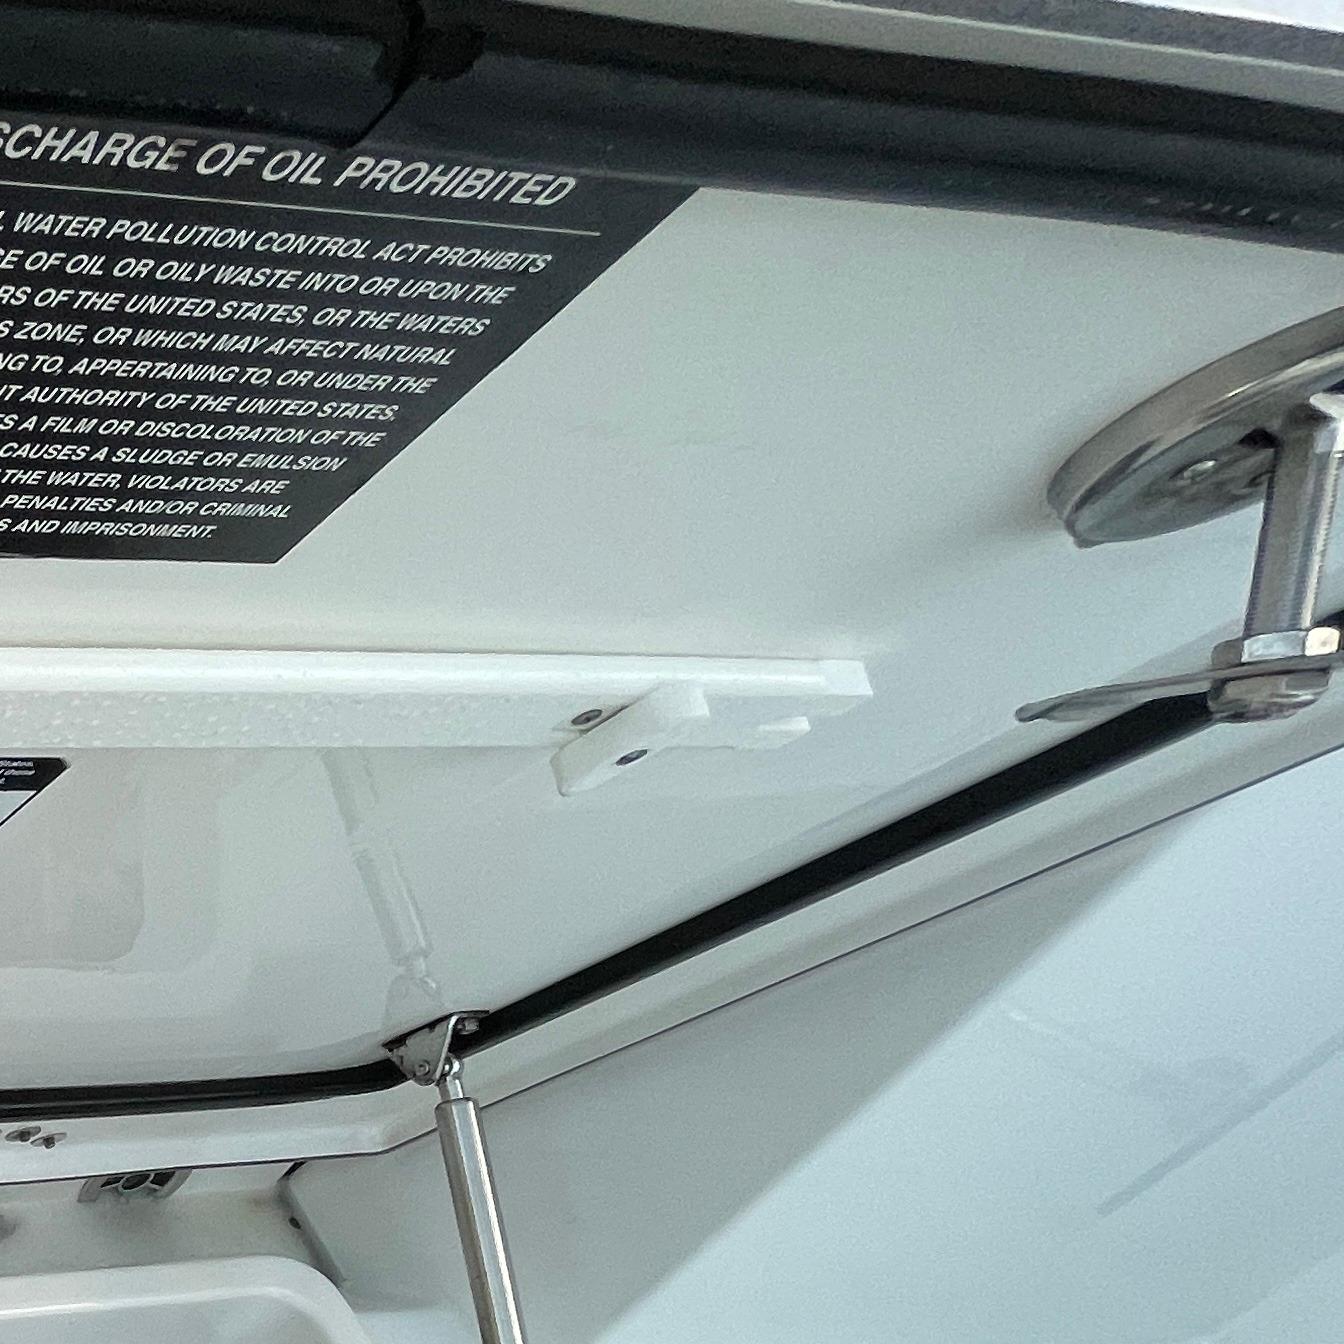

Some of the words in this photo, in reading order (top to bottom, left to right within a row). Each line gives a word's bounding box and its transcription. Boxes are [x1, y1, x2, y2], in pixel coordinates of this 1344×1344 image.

[196, 141, 260, 178] OF
[261, 146, 328, 186] OIL
[331, 156, 578, 206] PROHIBITED
[12, 210, 108, 239] WATER
[105, 218, 257, 250] POLLUTION
[254, 231, 372, 259] CONTROL
[371, 241, 432, 263] ACT
[423, 245, 553, 273] PROHIBITS
[24, 250, 68, 272] OF
[64, 254, 106, 276] OIL
[112, 257, 156, 279] OR
[154, 260, 217, 283] OILY
[212, 264, 303, 290] WASTE
[297, 271, 360, 294] INTO
[358, 276, 402, 297] OR
[397, 278, 470, 301] UPON
[464, 283, 516, 305] THE
[33, 287, 76, 308] OF
[72, 289, 126, 312] THE
[124, 293, 217, 318] UNITED
[215, 300, 309, 327] STATES,
[312, 307, 353, 327] OR
[349, 310, 402, 330] THE
[395, 312, 491, 336] WATERS
[12, 321, 88, 346] ZONE,
[92, 326, 133, 346] OR
[131, 328, 216, 351] WHICH
[210, 333, 269, 354] MAY
[263, 337, 361, 359] AFFECT
[353, 343, 457, 366] NATURAL
[30, 353, 65, 376] TO,
[67, 357, 241, 383] APPERTAINING
[238, 367, 273, 388] TO,
[276, 369, 316, 387] OR
[313, 371, 394, 392] UNDER
[390, 376, 439, 394] THE
[18, 385, 157, 409] AUTHORITY
[154, 392, 193, 410] OF
[189, 394, 238, 413] THE
[235, 396, 319, 417] UNITED
[17, 415, 39, 432] A
[39, 415, 99, 434] FILM
[97, 418, 136, 436] OR
[133, 420, 313, 444] DISCOLORATION
[309, 429, 347, 445] OF
[341, 430, 388, 447] THE
[88, 446, 110, 462] A
[111, 447, 206, 466] SLUDGE
[202, 451, 239, 468] OR
[235, 453, 348, 472] EMULSION
[0, 468, 48, 485] THE
[46, 470, 123, 491] WATER,
[127, 473, 244, 493] VIOLATORS
[240, 479, 291, 495] ARE
[0, 494, 118, 512] PENALTIES
[115, 498, 200, 515] AND/OR
[199, 502, 292, 518] CRIMINAL
[10, 518, 61, 534] AND
[59, 520, 218, 539] IMPRISONMENT.
